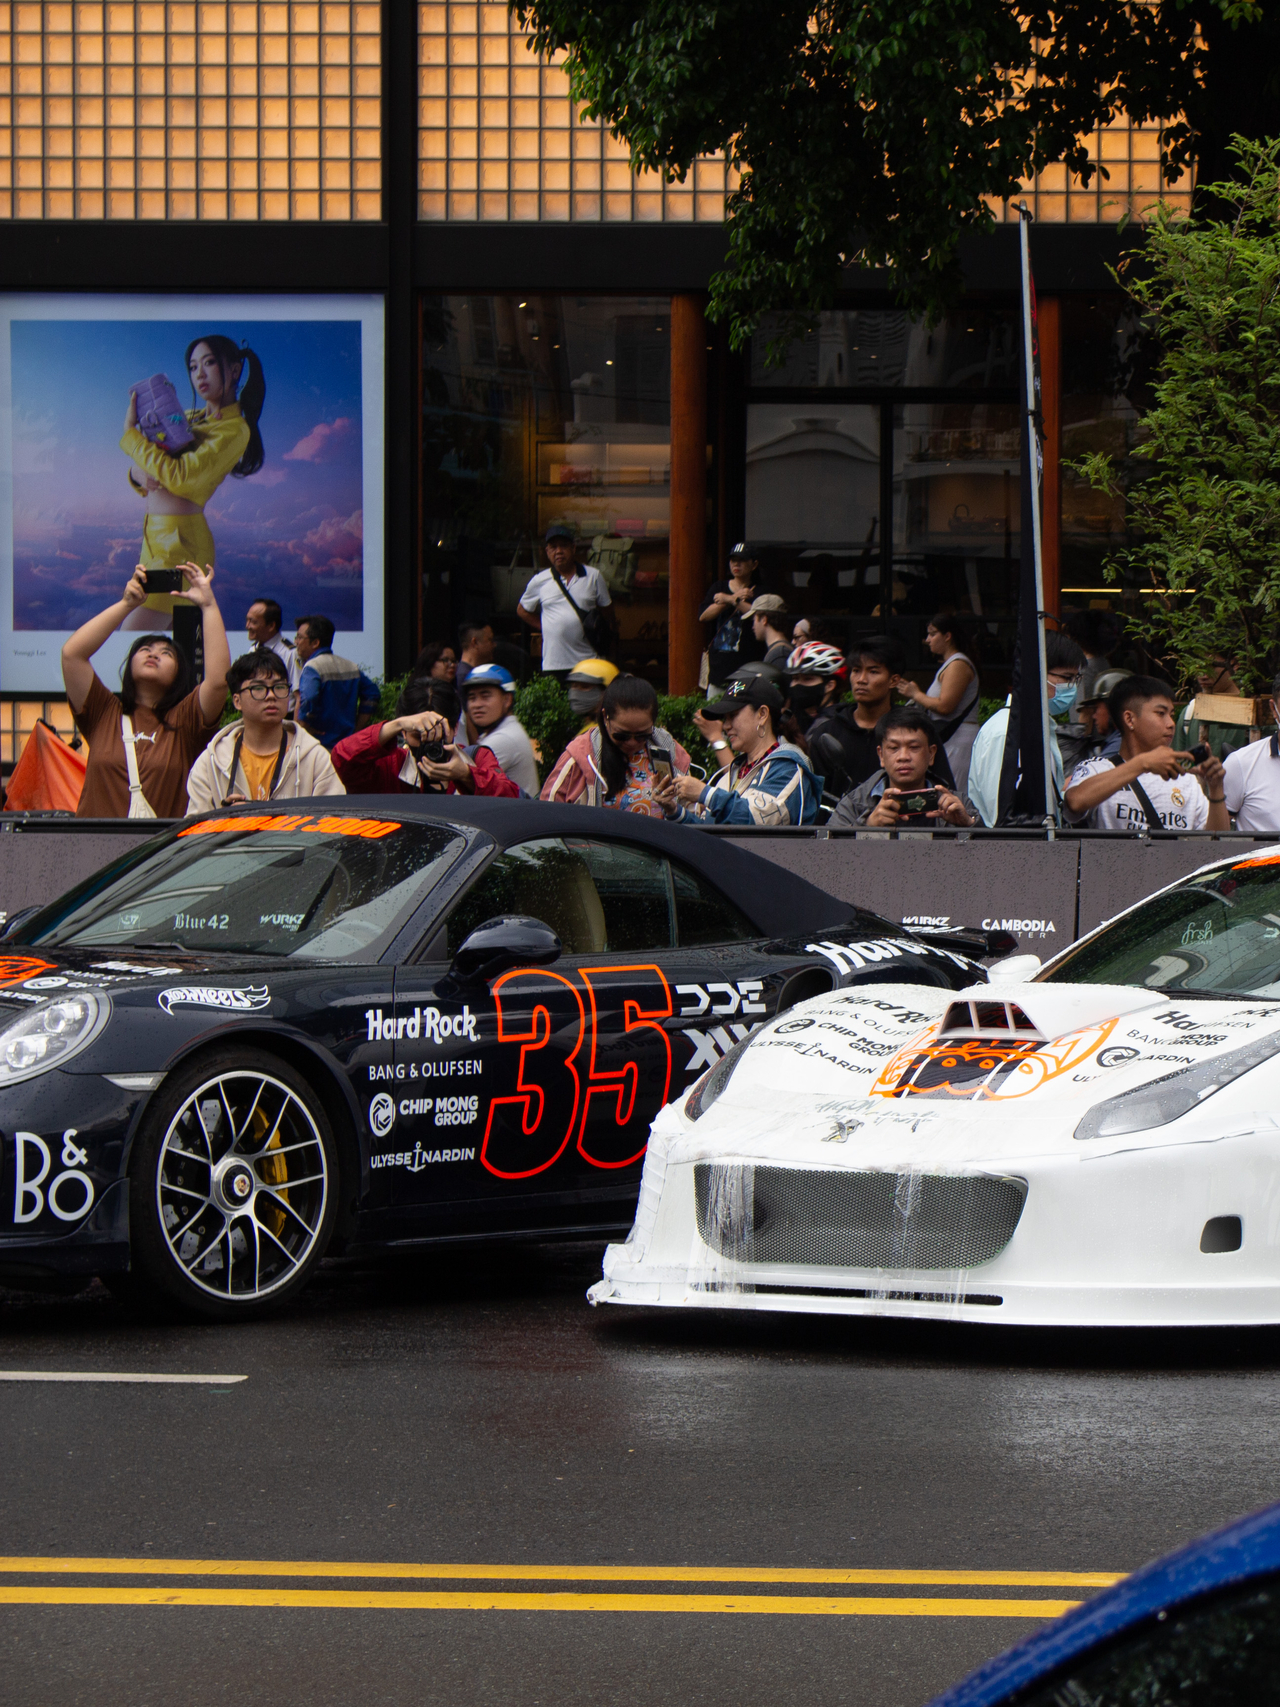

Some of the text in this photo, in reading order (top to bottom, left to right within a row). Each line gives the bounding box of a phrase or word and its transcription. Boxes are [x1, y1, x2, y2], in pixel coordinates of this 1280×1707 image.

[1116, 803, 1188, 829] Emates
[301, 816, 402, 839] 3000
[173, 913, 229, 930] Blue 42
[981, 918, 1056, 933] CAMBODIA
[676, 980, 767, 1017] DDE
[830, 995, 905, 1012] Hard
[804, 1009, 845, 1017] BANG
[365, 1005, 479, 1045] Hard Rock
[817, 1022, 858, 1038] CHIP
[749, 1040, 878, 1075] ULYSSE NARDIN
[369, 1059, 483, 1081] BANG & OLUFSEN
[480, 964, 673, 1180] 35
[399, 1095, 479, 1116] CHIP MONG
[434, 1111, 478, 1127] GROUP
[371, 1147, 476, 1169] ULYSSE NARDIN
[13, 1128, 96, 1224] B&O
